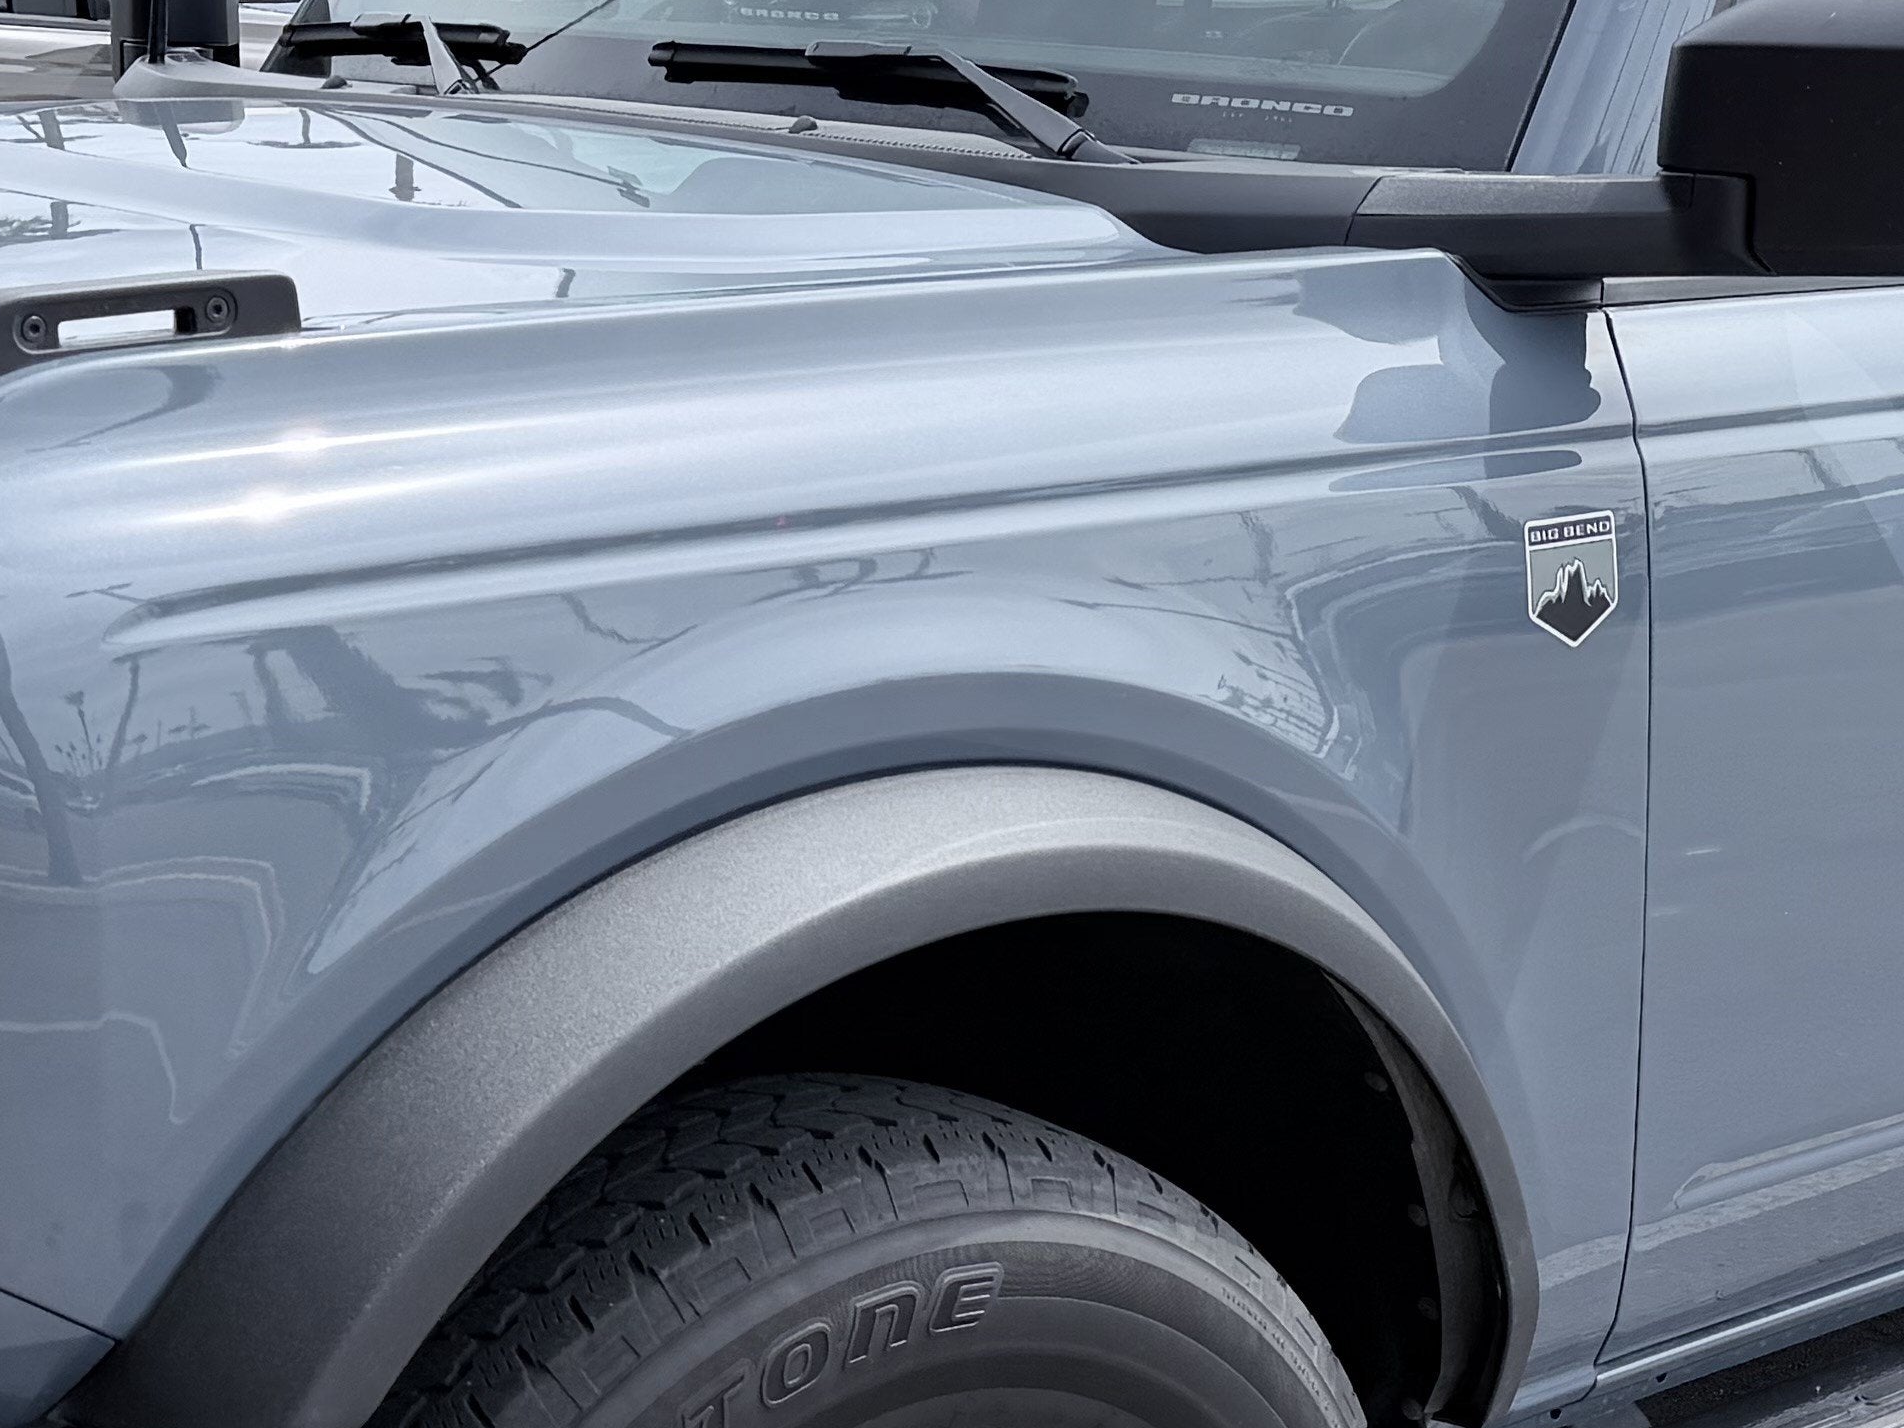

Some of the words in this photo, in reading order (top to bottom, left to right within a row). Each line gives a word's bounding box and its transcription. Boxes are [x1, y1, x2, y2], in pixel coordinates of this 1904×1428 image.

[1171, 93, 1354, 117] BRONCO
[1530, 527, 1559, 543] BIG
[1563, 521, 1610, 539] BEND
